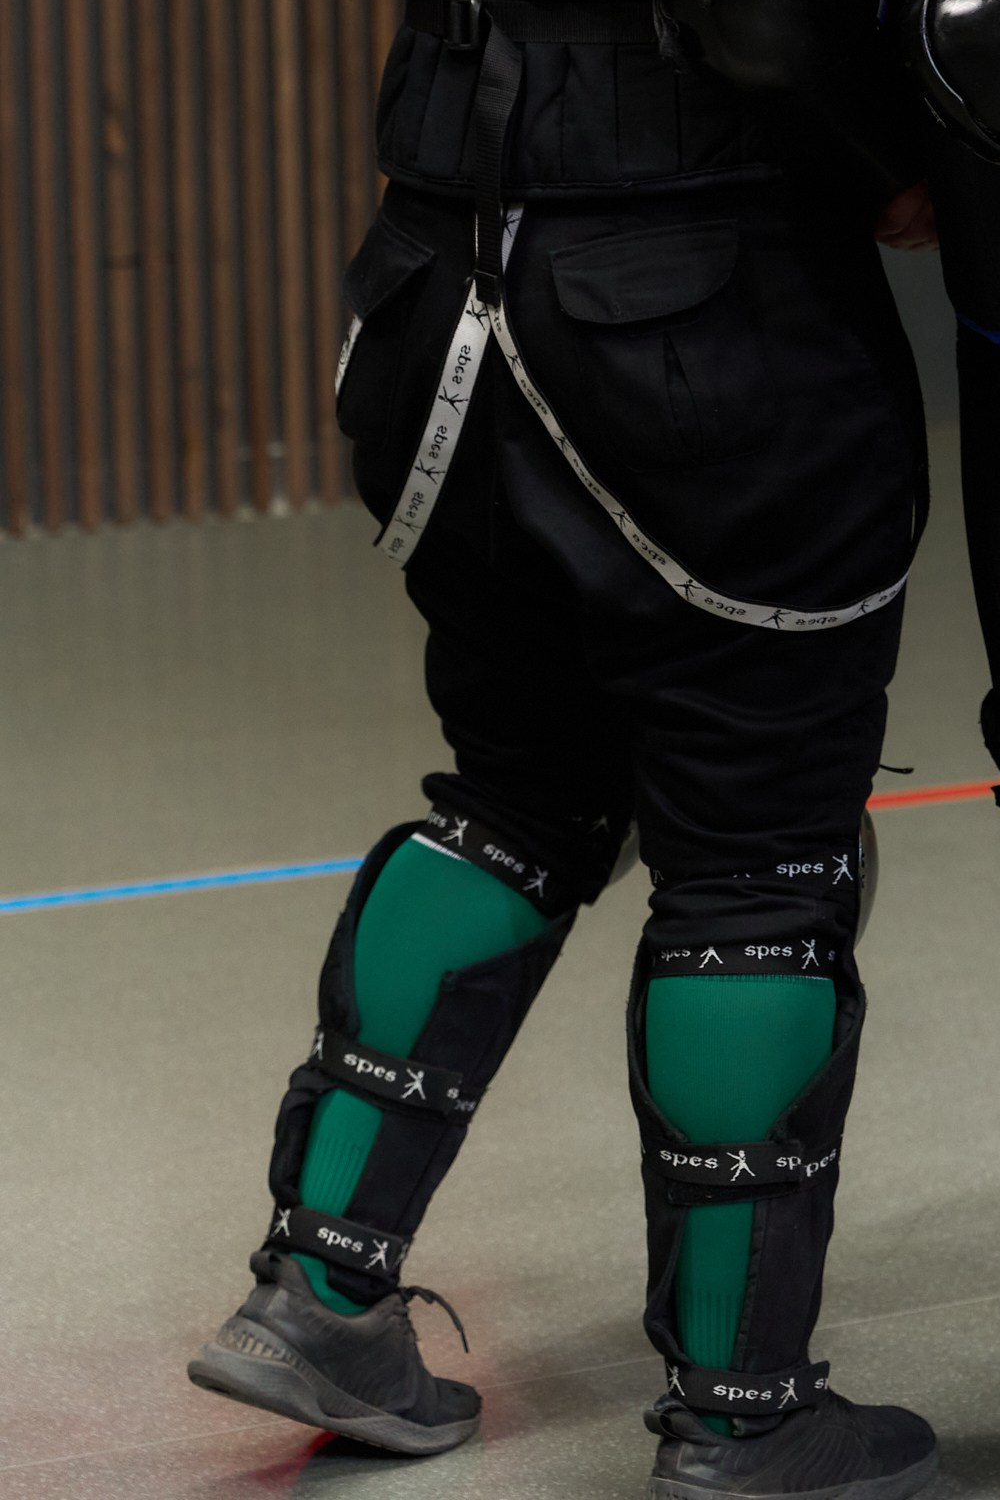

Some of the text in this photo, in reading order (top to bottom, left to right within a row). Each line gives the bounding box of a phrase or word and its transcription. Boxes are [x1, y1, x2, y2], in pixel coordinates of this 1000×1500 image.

[482, 843, 526, 874] spes
[776, 861, 825, 878] spes
[744, 943, 793, 960] spes
[343, 1053, 397, 1082] spes
[659, 1149, 719, 1169] spes
[316, 1226, 364, 1253] spes
[712, 1384, 772, 1401] spes
